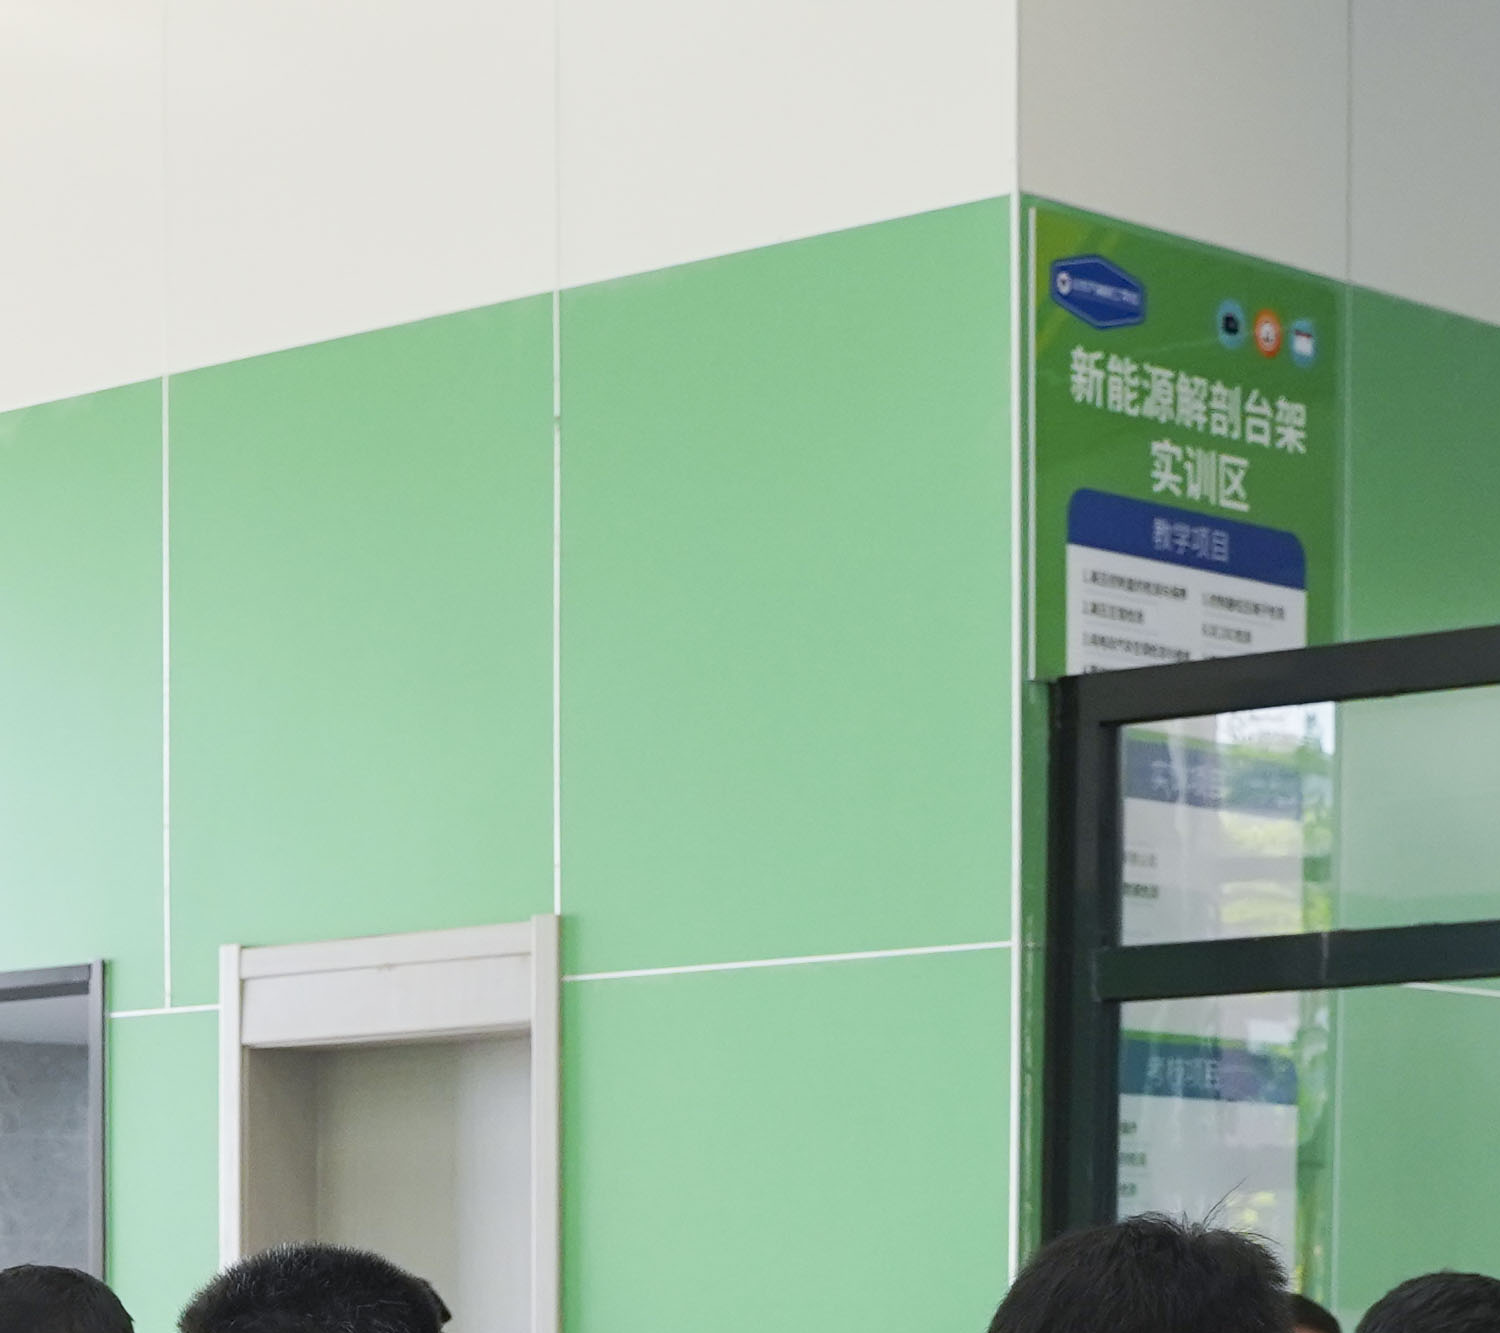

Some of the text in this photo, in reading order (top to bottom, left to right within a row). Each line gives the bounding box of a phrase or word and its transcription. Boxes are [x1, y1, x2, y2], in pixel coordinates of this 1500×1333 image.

[1070, 345, 1308, 454] 新能源解剖台架
[1150, 438, 1250, 512] 实训区
[1152, 517, 1230, 563] 教学项目
